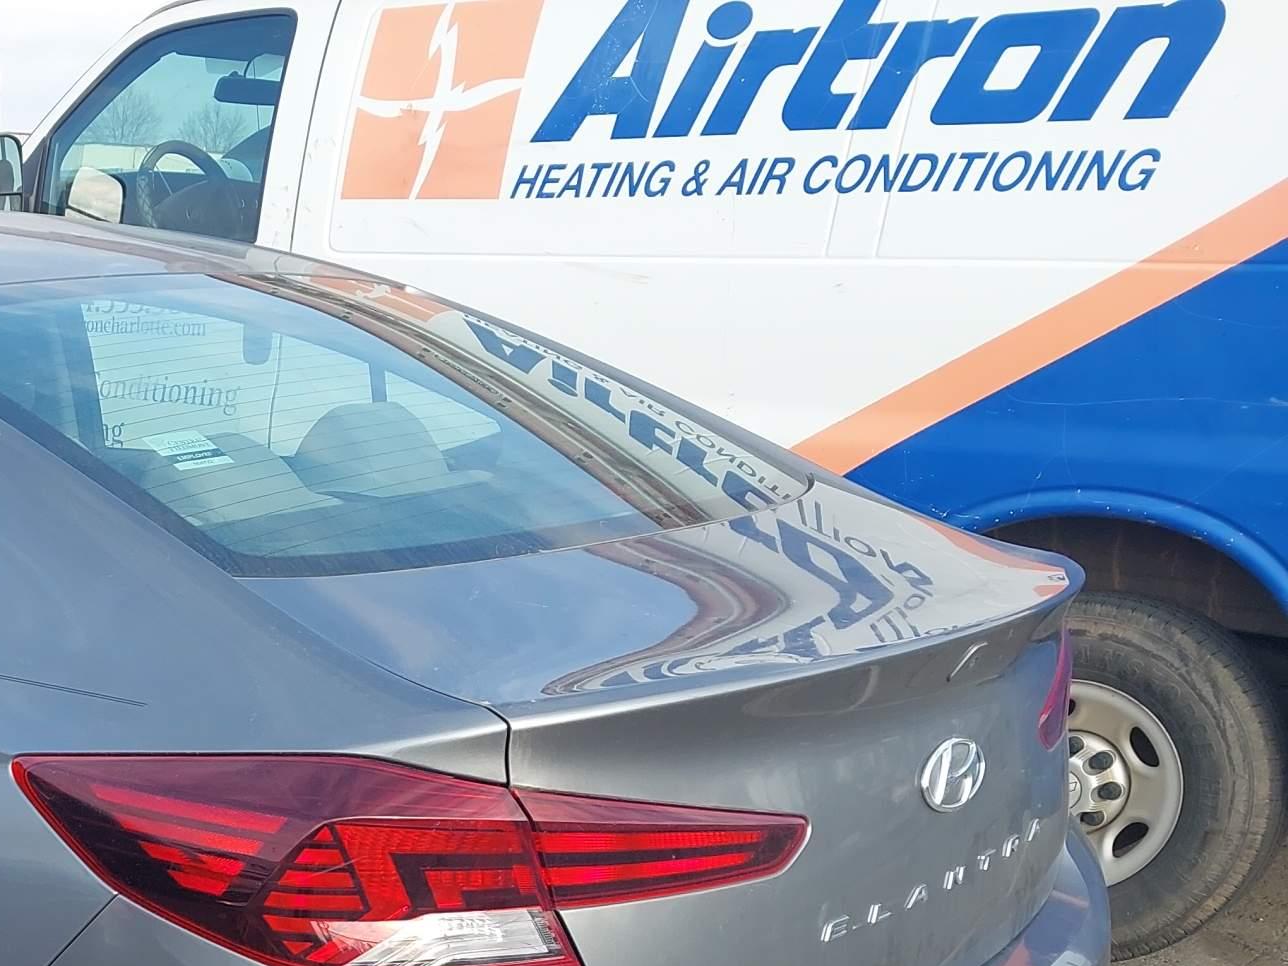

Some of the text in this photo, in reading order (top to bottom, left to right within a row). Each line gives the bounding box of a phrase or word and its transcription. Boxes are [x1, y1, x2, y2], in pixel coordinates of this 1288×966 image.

[530, 0, 1226, 143] Airtron
[510, 148, 1161, 199] HEATING & AIR CONDITIONING
[820, 818, 1040, 942] ELANTRA
